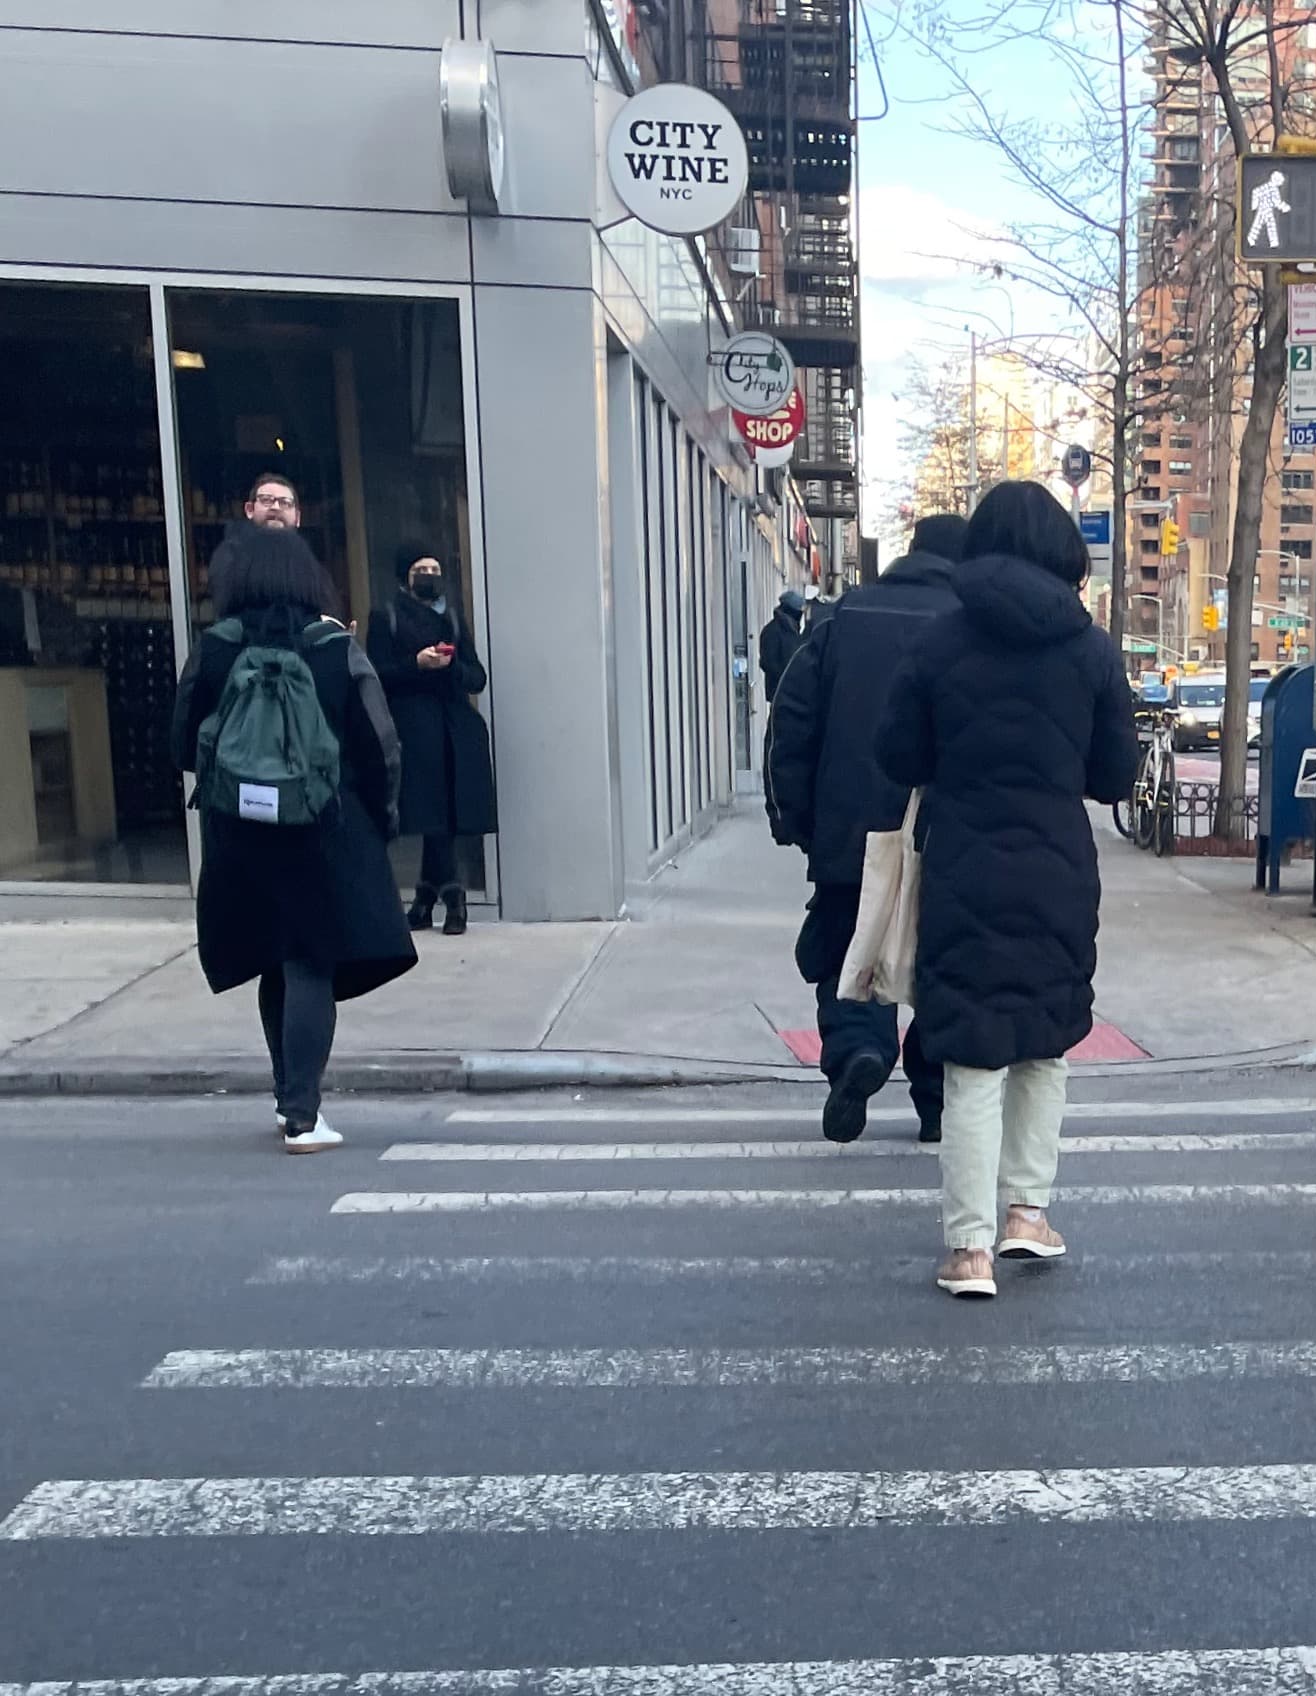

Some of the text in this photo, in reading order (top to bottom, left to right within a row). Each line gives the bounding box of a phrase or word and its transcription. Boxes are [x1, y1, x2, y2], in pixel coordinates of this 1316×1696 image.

[629, 120, 722, 150] CITY
[624, 152, 729, 184] WINE
[660, 187, 693, 200] NYC
[1295, 347, 1308, 369] 2
[746, 420, 793, 442] SHOP
